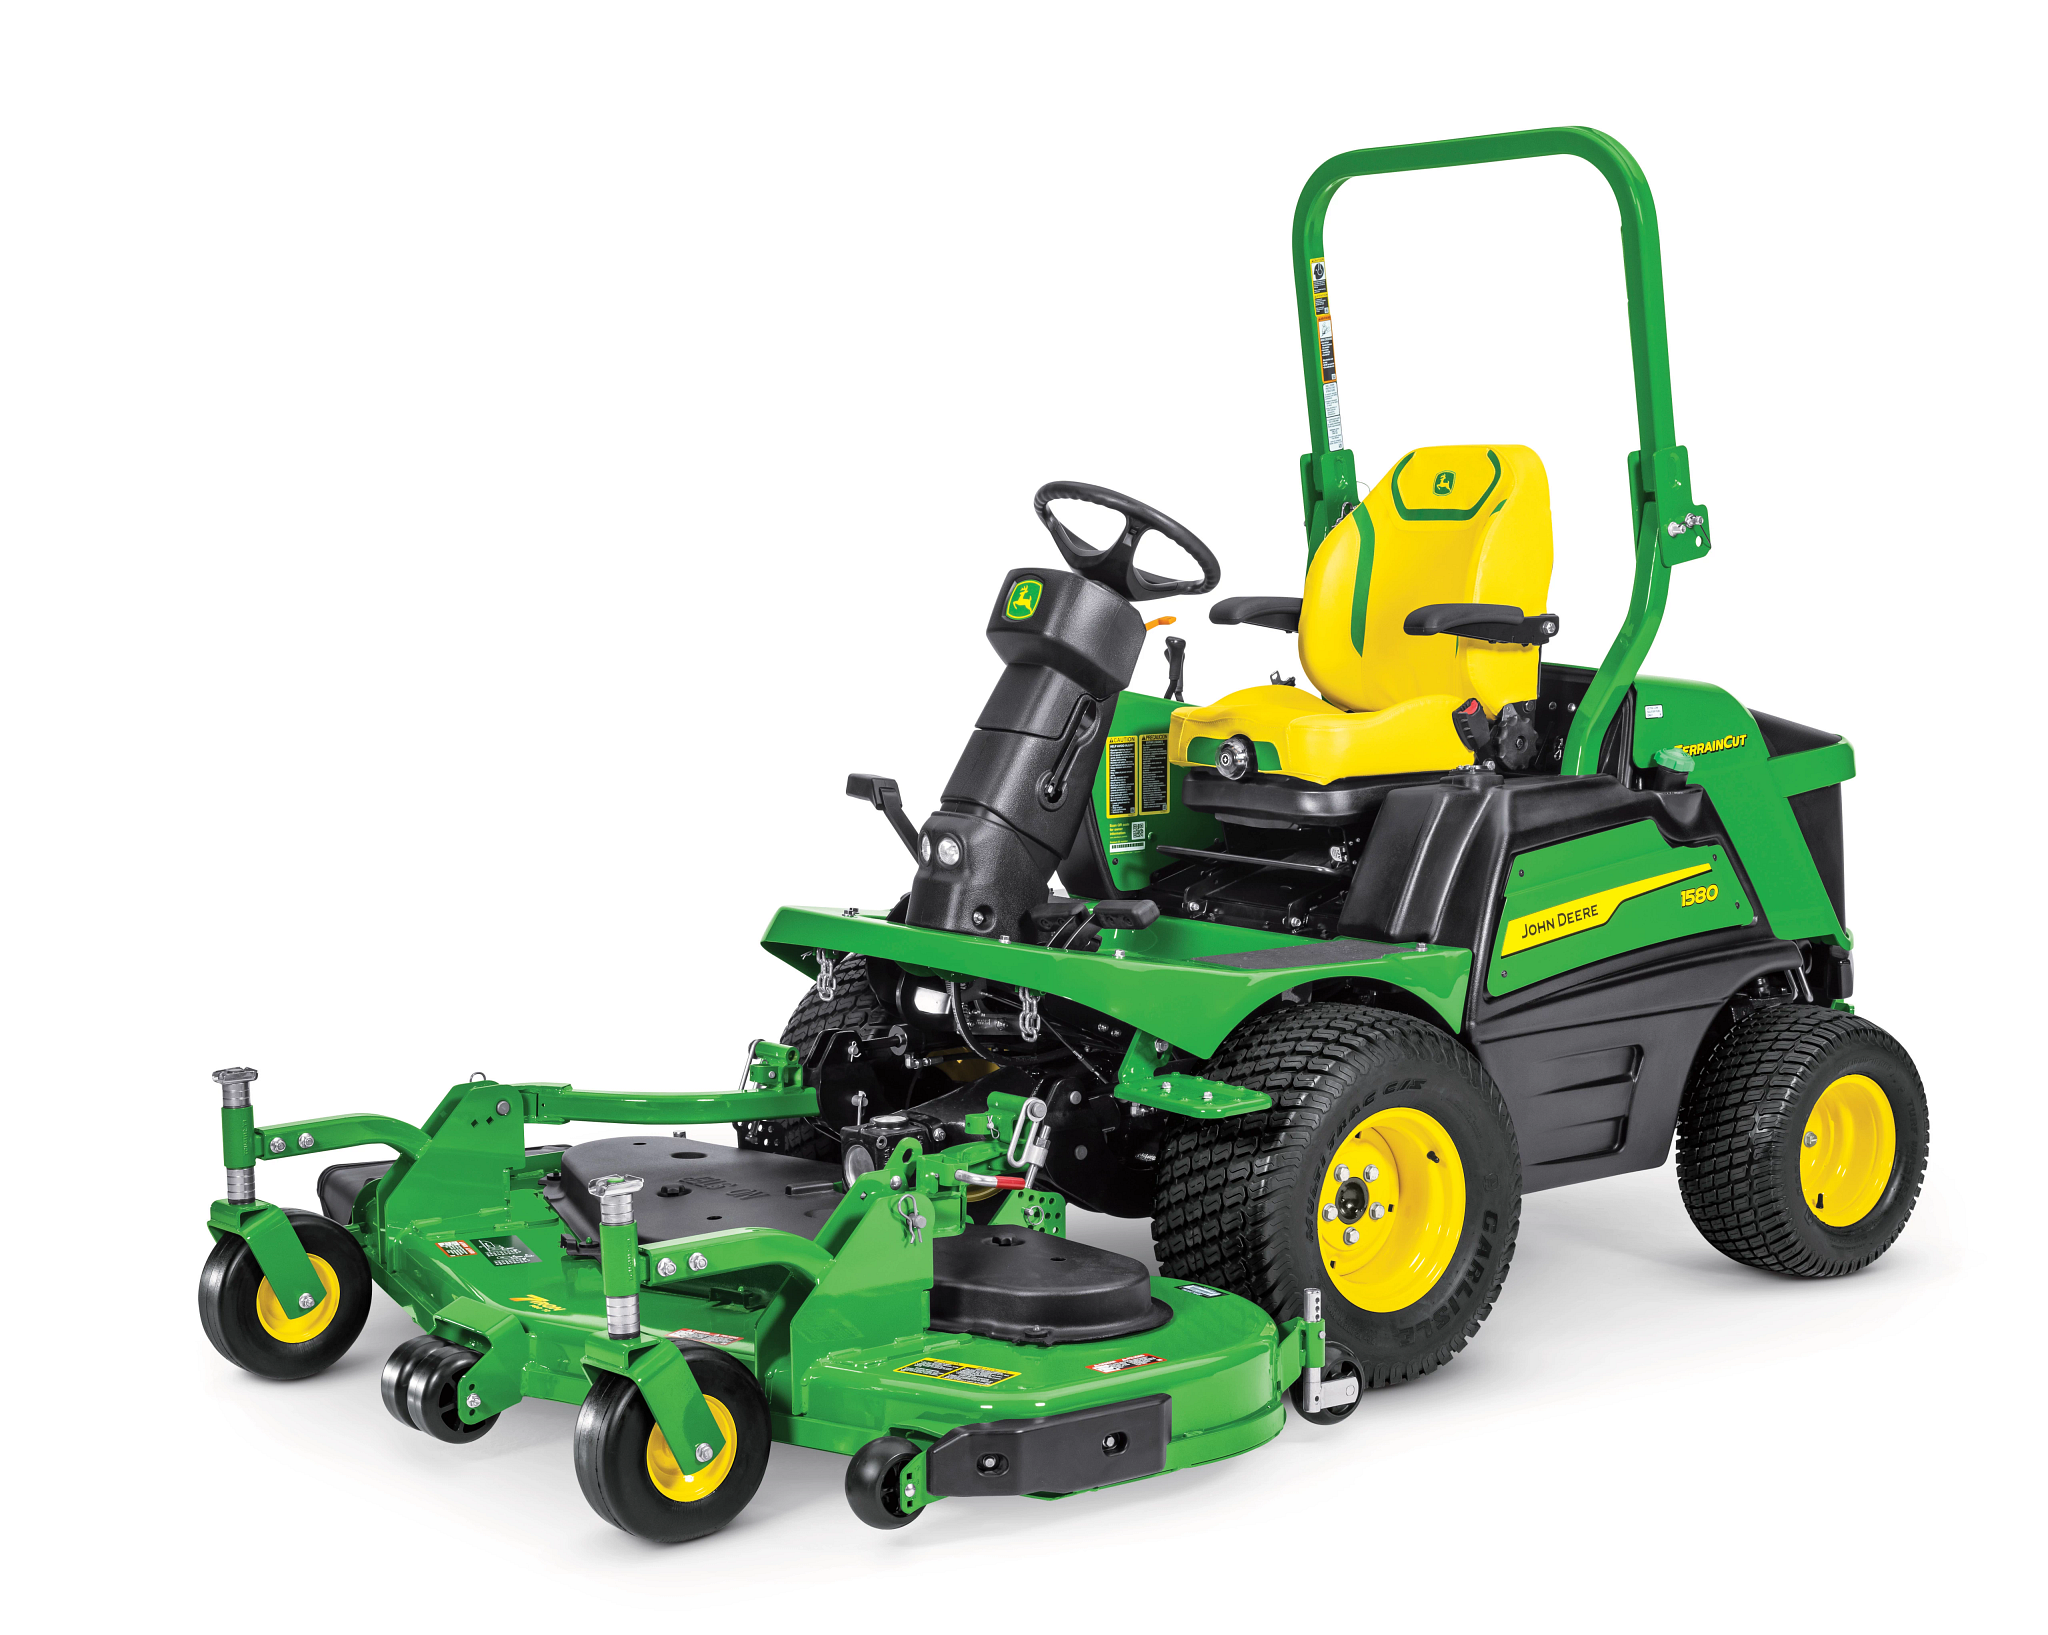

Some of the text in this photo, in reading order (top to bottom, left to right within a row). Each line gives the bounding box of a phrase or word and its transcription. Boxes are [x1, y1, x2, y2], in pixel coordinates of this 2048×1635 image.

[1521, 904, 1599, 939] JOHN DEERE
[1681, 884, 1719, 908] 1580
[1305, 1154, 1326, 1243] MULTI
[1327, 1091, 1376, 1154] TRAC
[1399, 1209, 1499, 1347] CARLISLE
